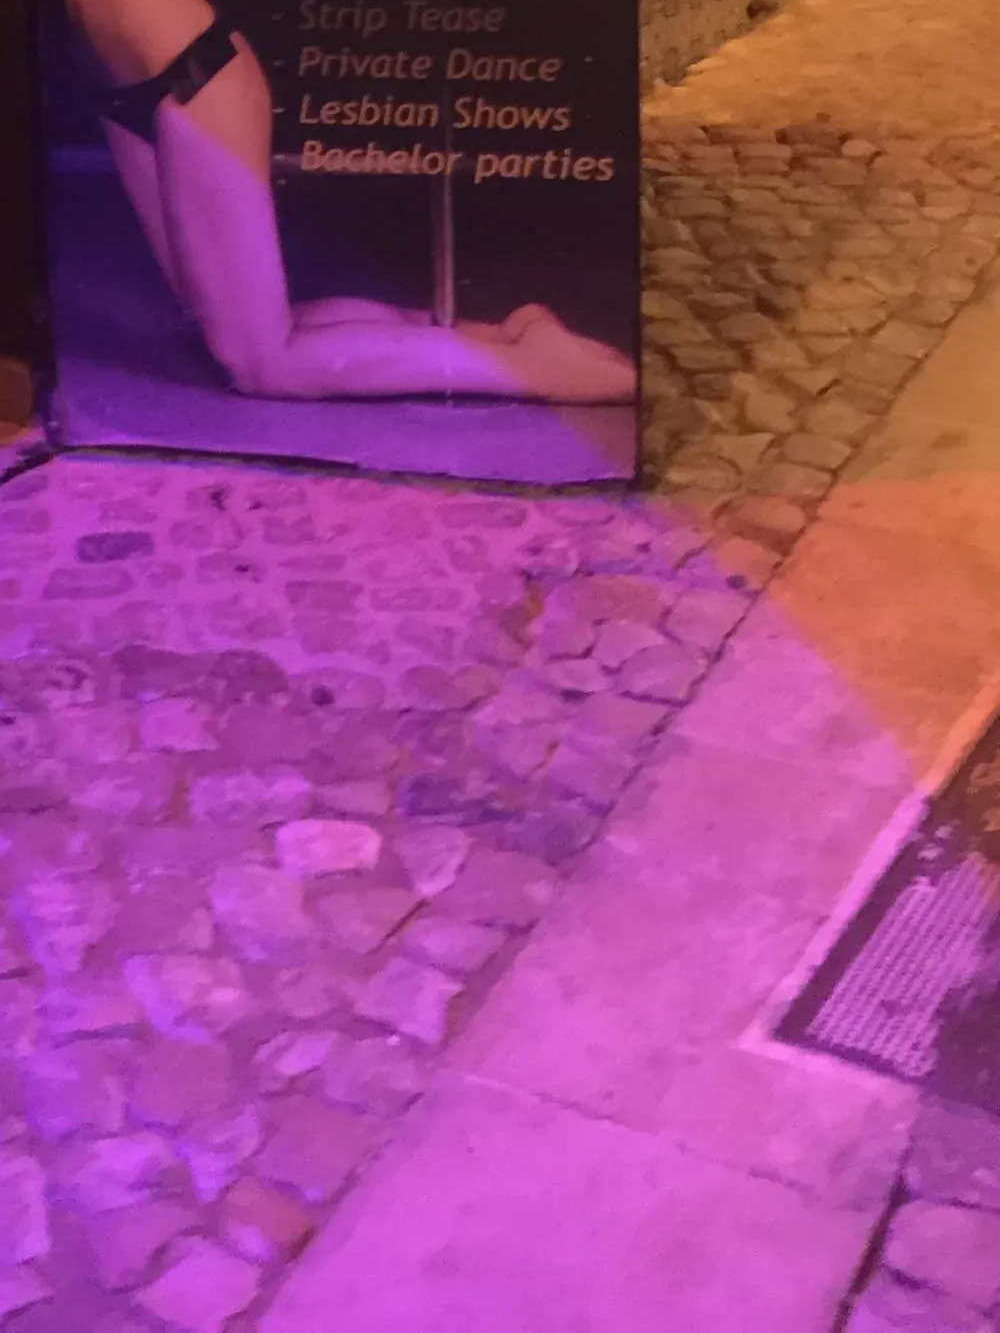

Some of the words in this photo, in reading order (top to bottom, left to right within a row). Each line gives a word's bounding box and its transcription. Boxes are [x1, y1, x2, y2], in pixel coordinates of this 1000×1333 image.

[298, 0, 387, 37] Strip
[403, 0, 507, 33] Tease
[299, 46, 431, 79] Private
[446, 48, 563, 82] Dance
[300, 95, 439, 127] Lesbian
[453, 97, 572, 131] Shows
[301, 140, 465, 175] Bachelor
[474, 149, 615, 184] parties
